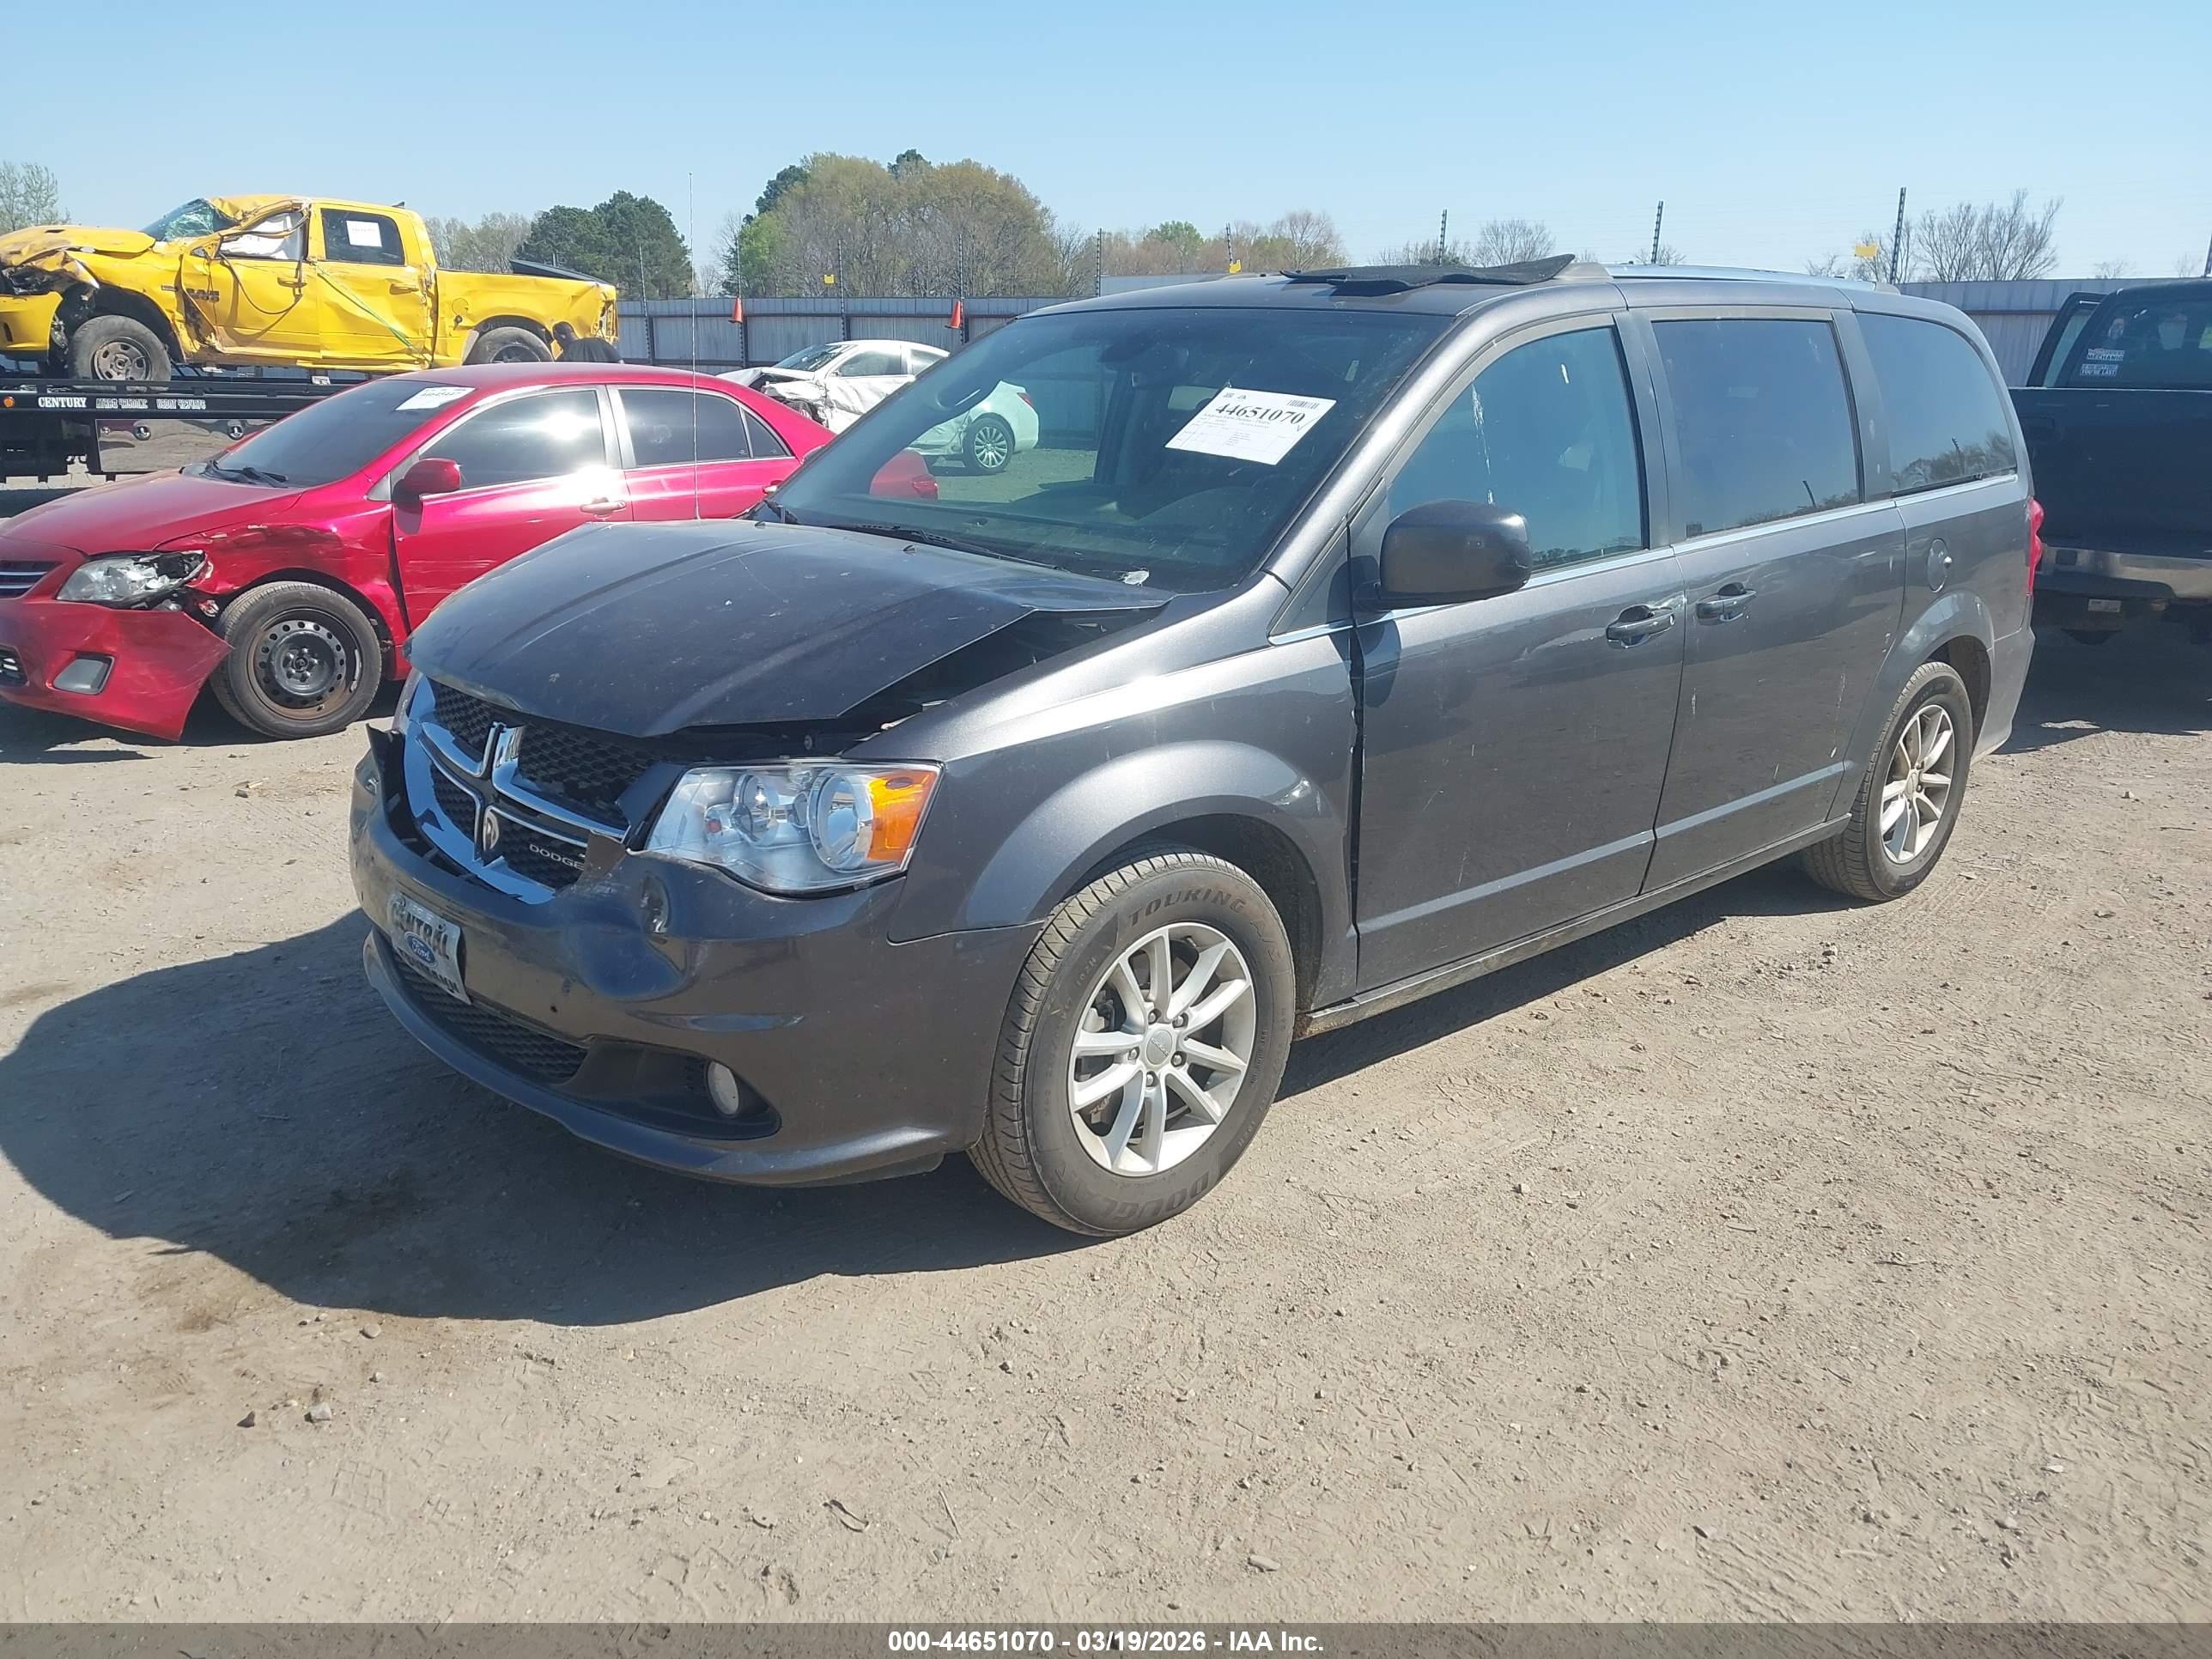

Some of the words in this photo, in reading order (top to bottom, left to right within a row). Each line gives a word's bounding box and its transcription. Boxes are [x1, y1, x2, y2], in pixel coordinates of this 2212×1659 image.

[38, 397, 87, 408] CENTURY
[1215, 403, 1306, 425] 44651070
[529, 843, 585, 871] DODGE
[1128, 888, 1247, 927] TOURING
